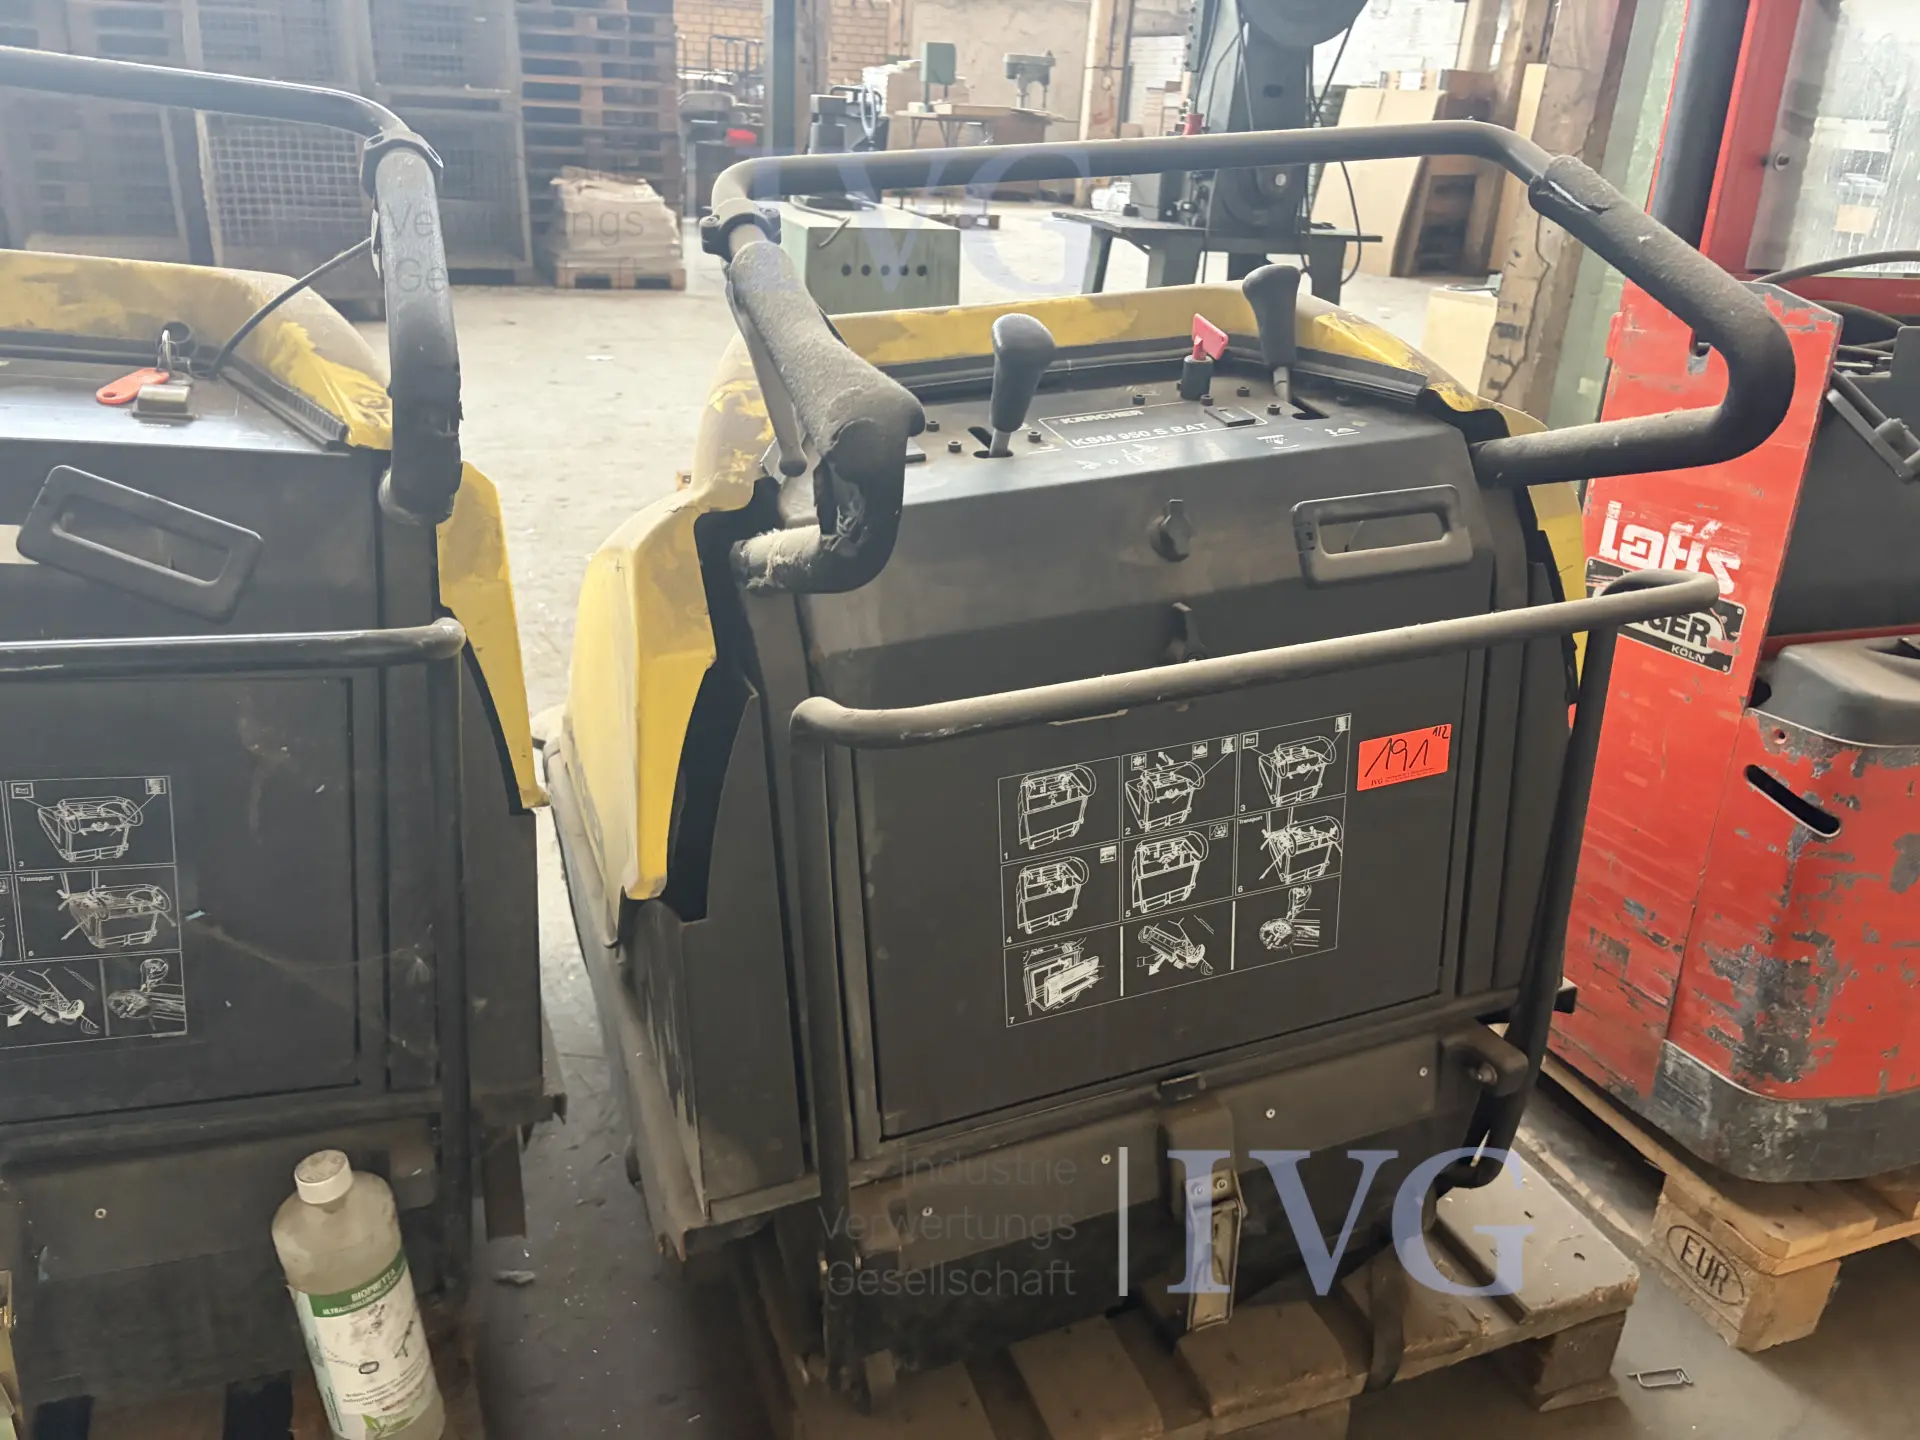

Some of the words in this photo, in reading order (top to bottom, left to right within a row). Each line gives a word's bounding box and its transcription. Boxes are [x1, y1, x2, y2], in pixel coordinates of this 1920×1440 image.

[1072, 434, 1117, 447] KSM
[1117, 430, 1151, 441] 950
[1152, 427, 1169, 437] S
[1169, 421, 1209, 434] BAT
[1671, 643, 1706, 664] KÖLN
[1364, 737, 1429, 778] 191
[1239, 803, 1247, 813] 3
[1239, 815, 1263, 825] Transport
[1124, 826, 1131, 836] 2
[1003, 851, 1009, 860] 1
[1237, 884, 1244, 894] 6
[1125, 909, 1132, 918] 5
[1006, 935, 1013, 944] 4
[1008, 1015, 1015, 1025] 7
[1680, 1234, 1730, 1296] EUR
